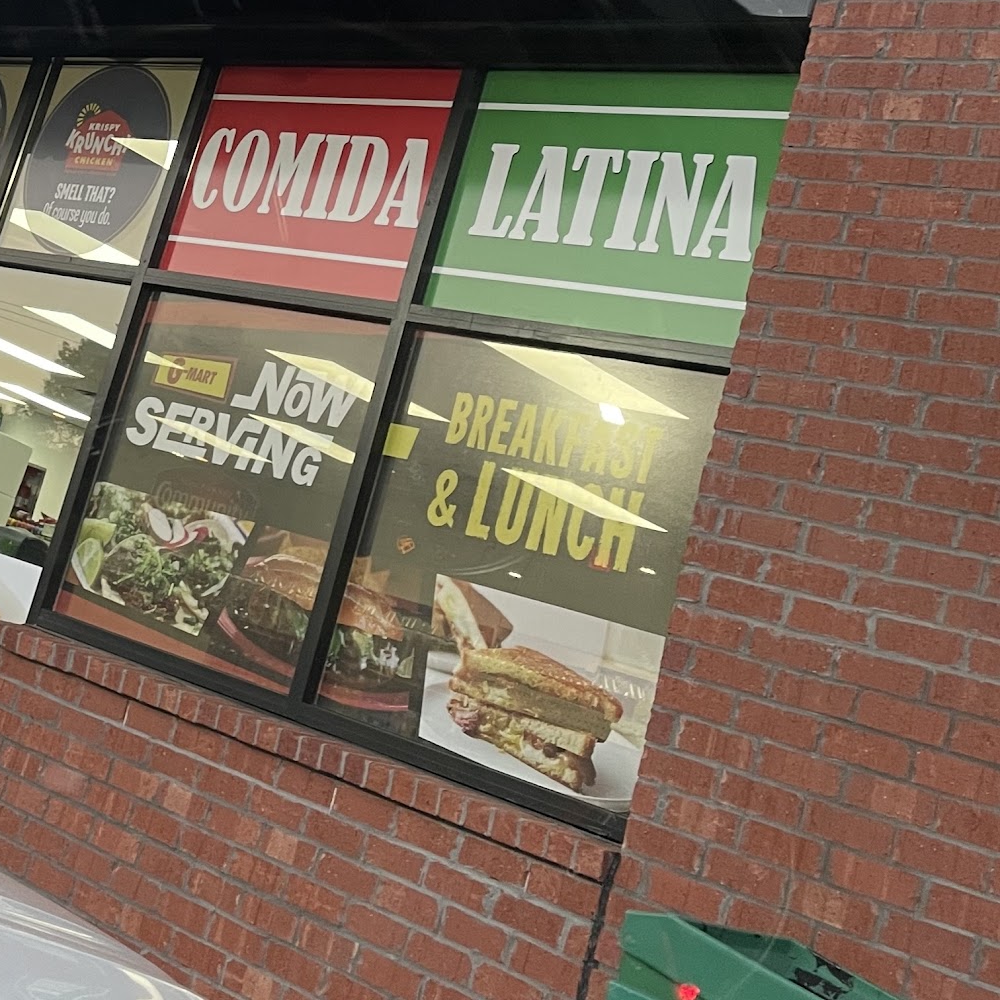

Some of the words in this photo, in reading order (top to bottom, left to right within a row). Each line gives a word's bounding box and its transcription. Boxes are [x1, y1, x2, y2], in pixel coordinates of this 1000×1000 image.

[65, 128, 132, 157] KRUNCH
[87, 122, 122, 132] KRISPY
[74, 155, 115, 167] CHICKEN
[192, 127, 430, 229] COMIDA
[53, 203, 80, 222] course
[79, 208, 99, 228] you
[97, 205, 112, 226] do.
[54, 182, 85, 201] SMELL
[84, 184, 117, 204] THAT?
[468, 142, 758, 262] LATINA
[126, 396, 334, 487] SERVING
[445, 391, 665, 485] BREAKFAST
[426, 468, 459, 528] &
[464, 460, 645, 573] LUNCH
